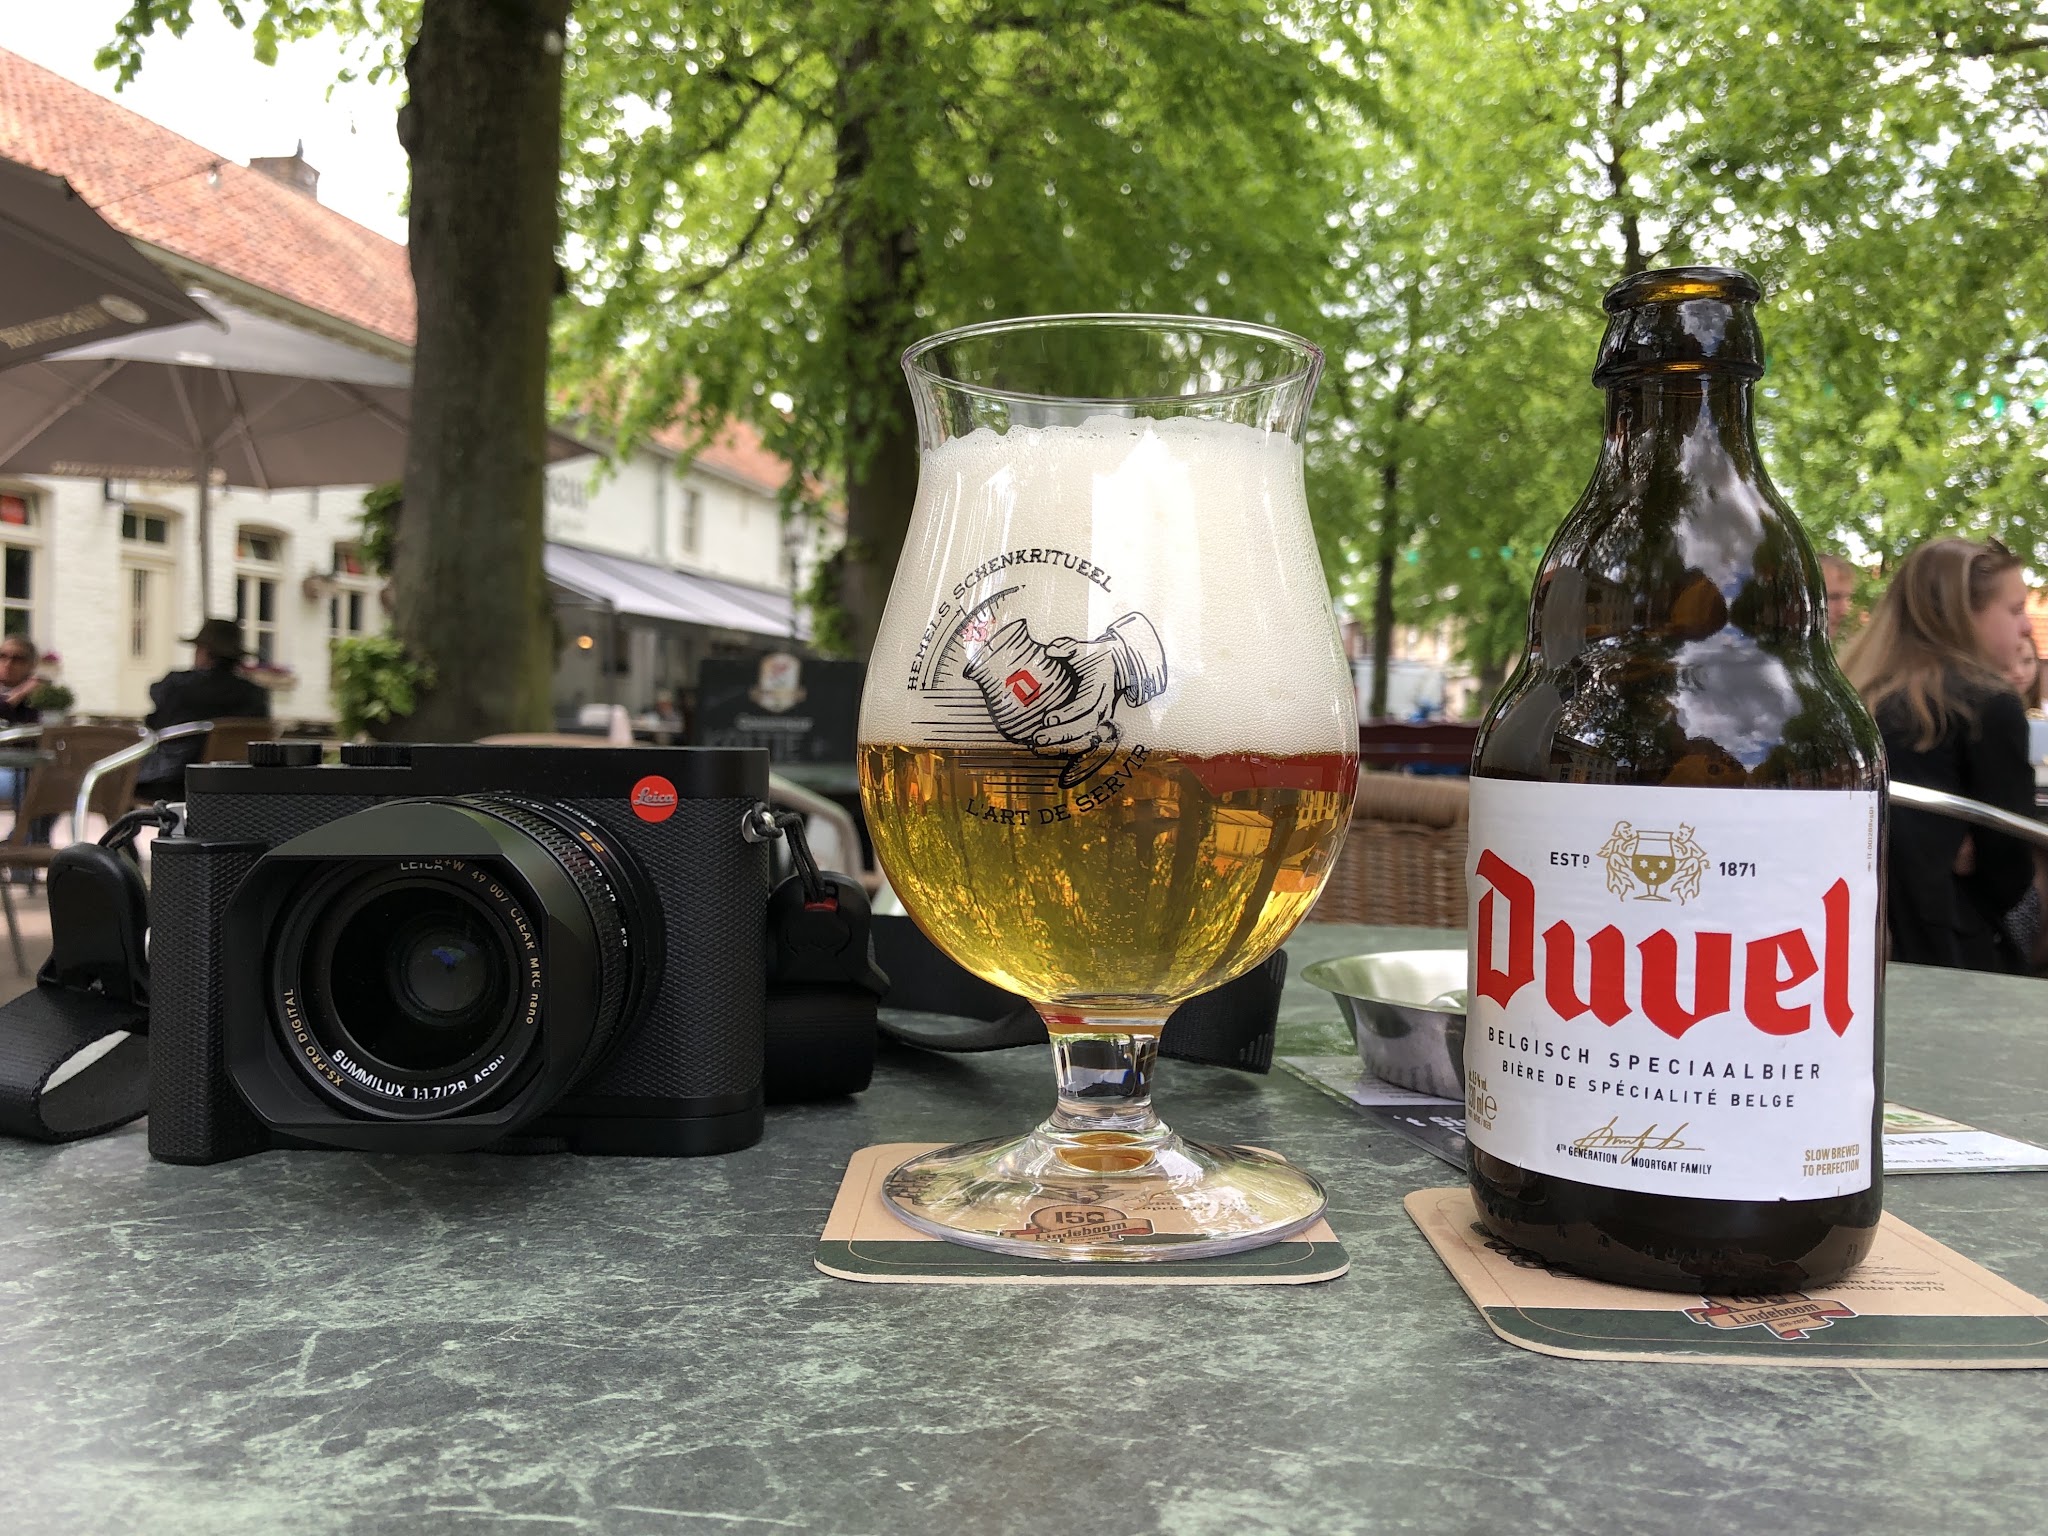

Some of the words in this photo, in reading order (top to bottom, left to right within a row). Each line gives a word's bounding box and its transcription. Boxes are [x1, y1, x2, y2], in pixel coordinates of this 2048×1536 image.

[907, 601, 951, 691] HEMELS
[953, 548, 1112, 600] SCHENKRITUEEL
[633, 787, 676, 806] Leica
[966, 798, 1030, 825] L'ART
[1038, 804, 1071, 825] DE
[1076, 744, 1152, 813] SERVIR
[1719, 861, 1756, 877] 1871
[471, 871, 487, 883] 49
[526, 993, 539, 1024] nano
[1475, 849, 1856, 1040] Duvel
[284, 988, 309, 1043] DIGITAL
[305, 1046, 344, 1087] XS-PRO
[332, 1049, 405, 1097] SUMMILUX
[1488, 1026, 1590, 1065] BELGISCH
[1609, 1052, 1821, 1080] SPECIAALBIER
[1502, 1060, 1545, 1083] BIÈRE
[1555, 1074, 1577, 1090] DE
[1588, 1079, 1717, 1106] SPÉCIALITÉ
[1731, 1094, 1795, 1108] BELGE
[1568, 1146, 1618, 1165] GENERATION
[1631, 1155, 1677, 1172] MOORTGAT
[1680, 1162, 1712, 1175] FAMILY
[1803, 1164, 1814, 1177] TO
[1816, 1158, 1860, 1176] PERFECTION
[1805, 1148, 1830, 1161] SLOW
[1832, 1143, 1860, 1159] BREWED
[1728, 1303, 1821, 1325] Lindeboom
